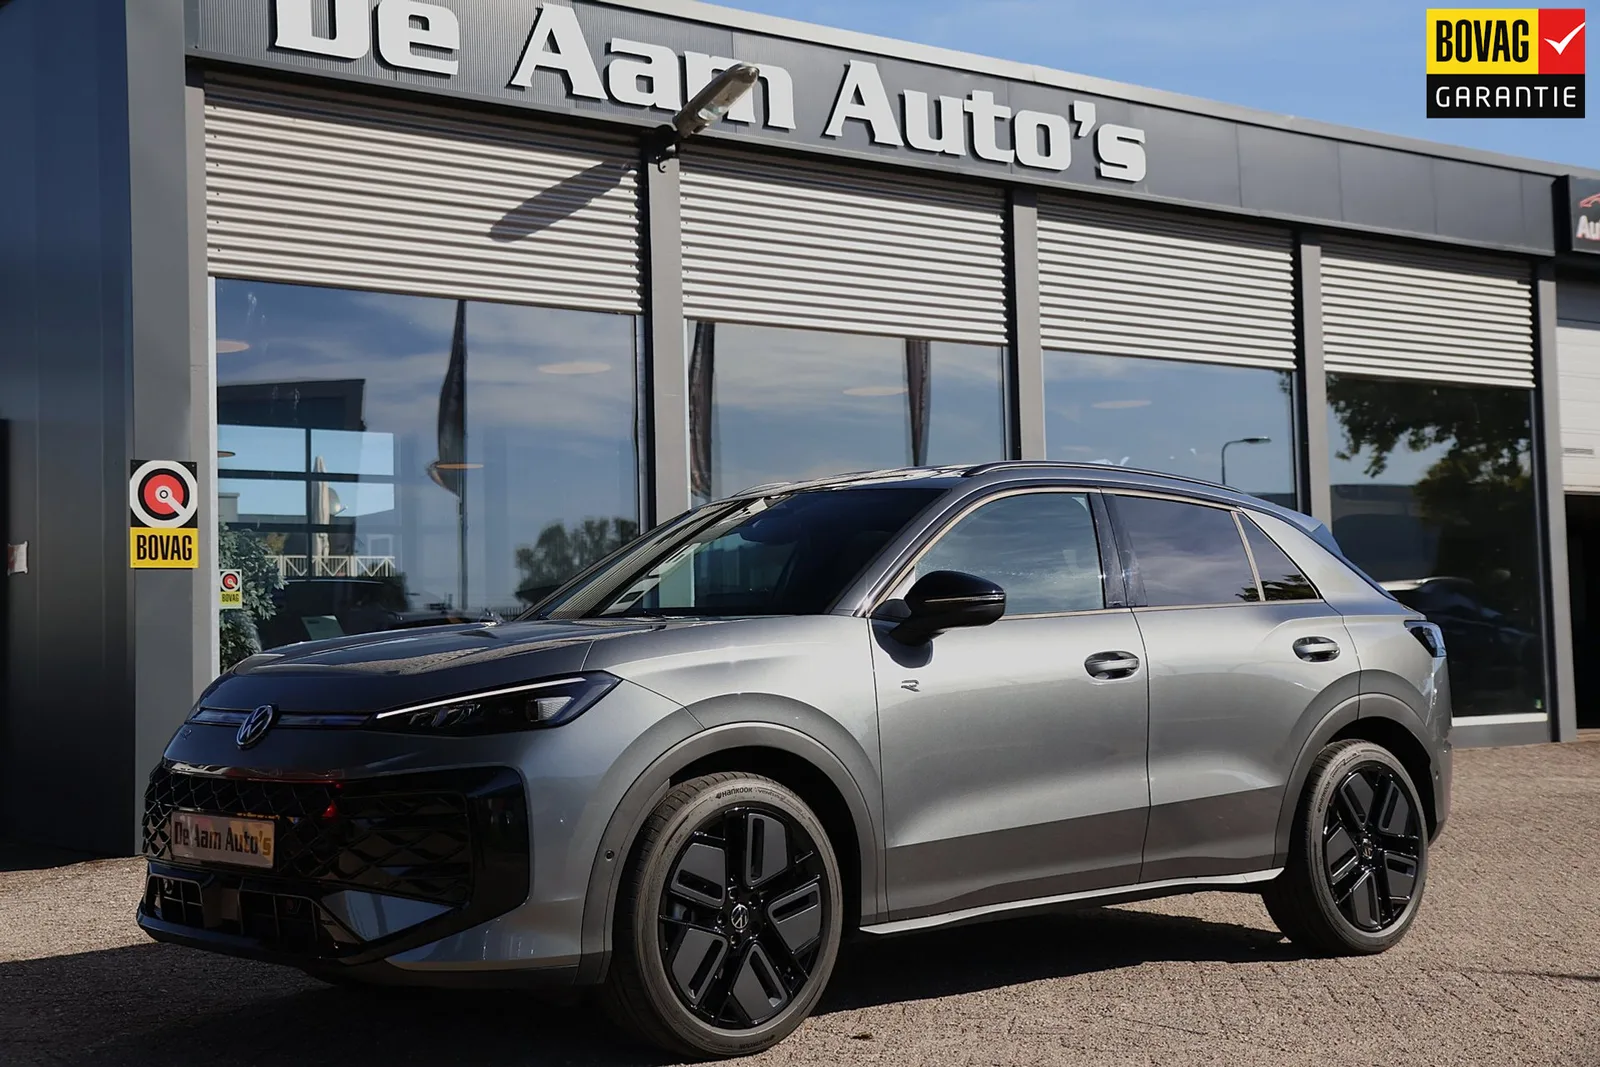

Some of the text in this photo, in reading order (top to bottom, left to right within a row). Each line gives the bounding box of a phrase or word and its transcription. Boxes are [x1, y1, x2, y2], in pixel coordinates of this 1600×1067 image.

[511, 3, 797, 130] Aam
[825, 59, 1147, 182] Auto's
[1576, 215, 1600, 240] Au
[136, 534, 193, 561] BOVAG
[221, 593, 239, 603] BOVAG
[174, 821, 190, 846] De
[225, 826, 272, 856] Auto's
